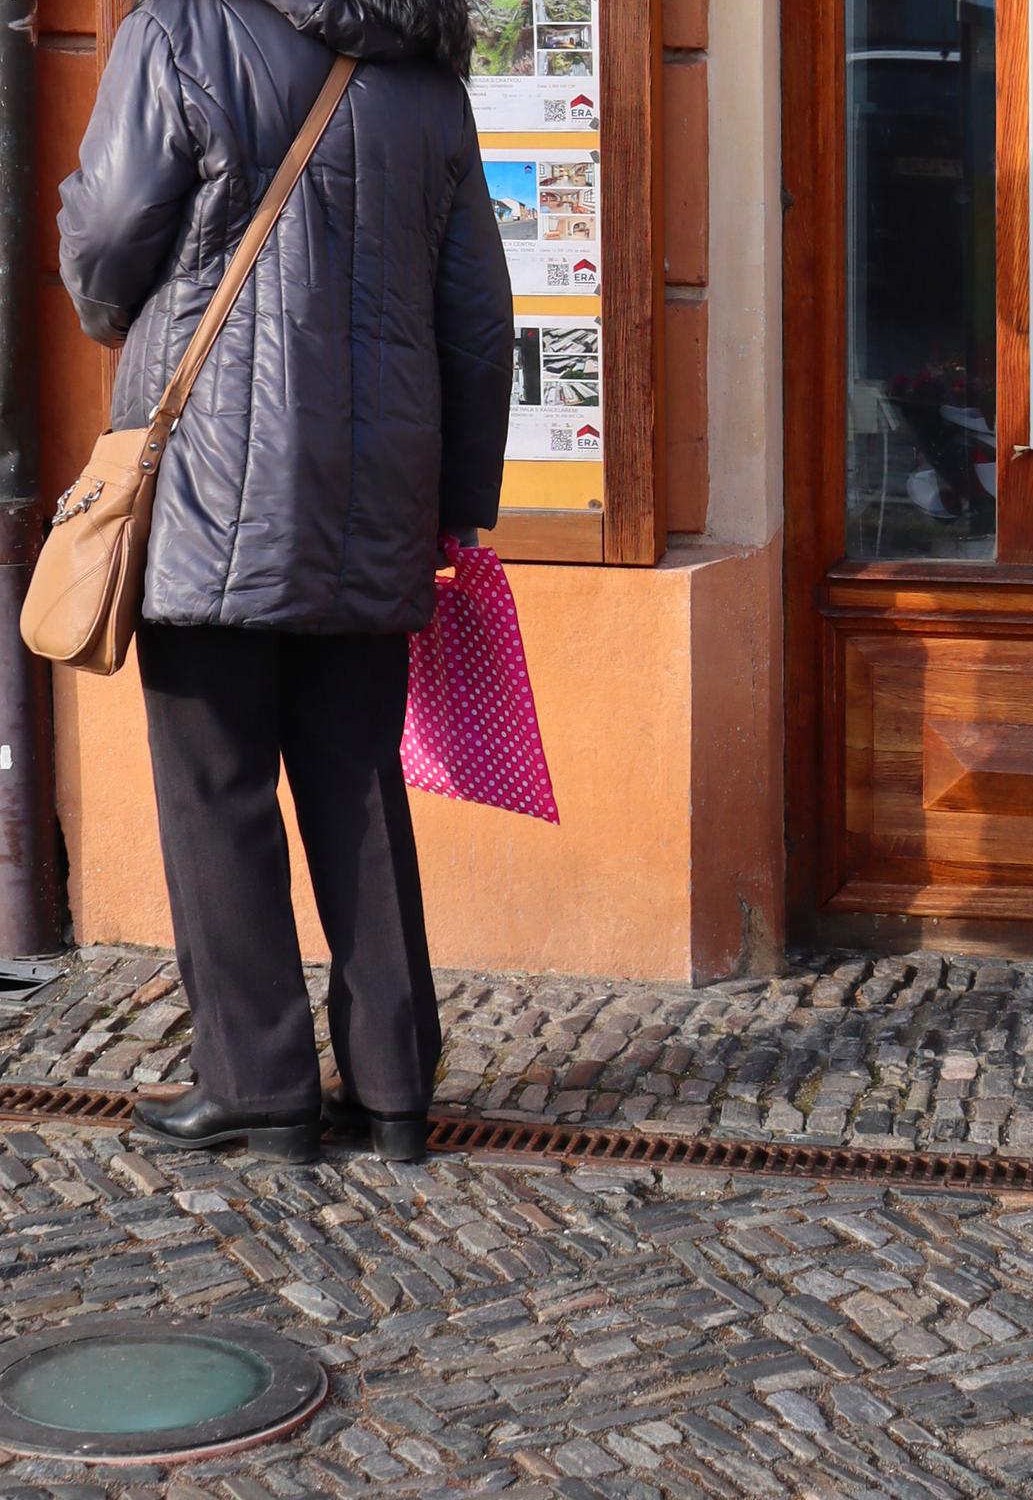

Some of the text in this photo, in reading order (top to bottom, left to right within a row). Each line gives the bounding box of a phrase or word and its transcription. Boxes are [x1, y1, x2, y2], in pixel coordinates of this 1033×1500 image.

[571, 108, 593, 117] ERA
[574, 273, 596, 281] ERA
[577, 438, 599, 447] ERA
